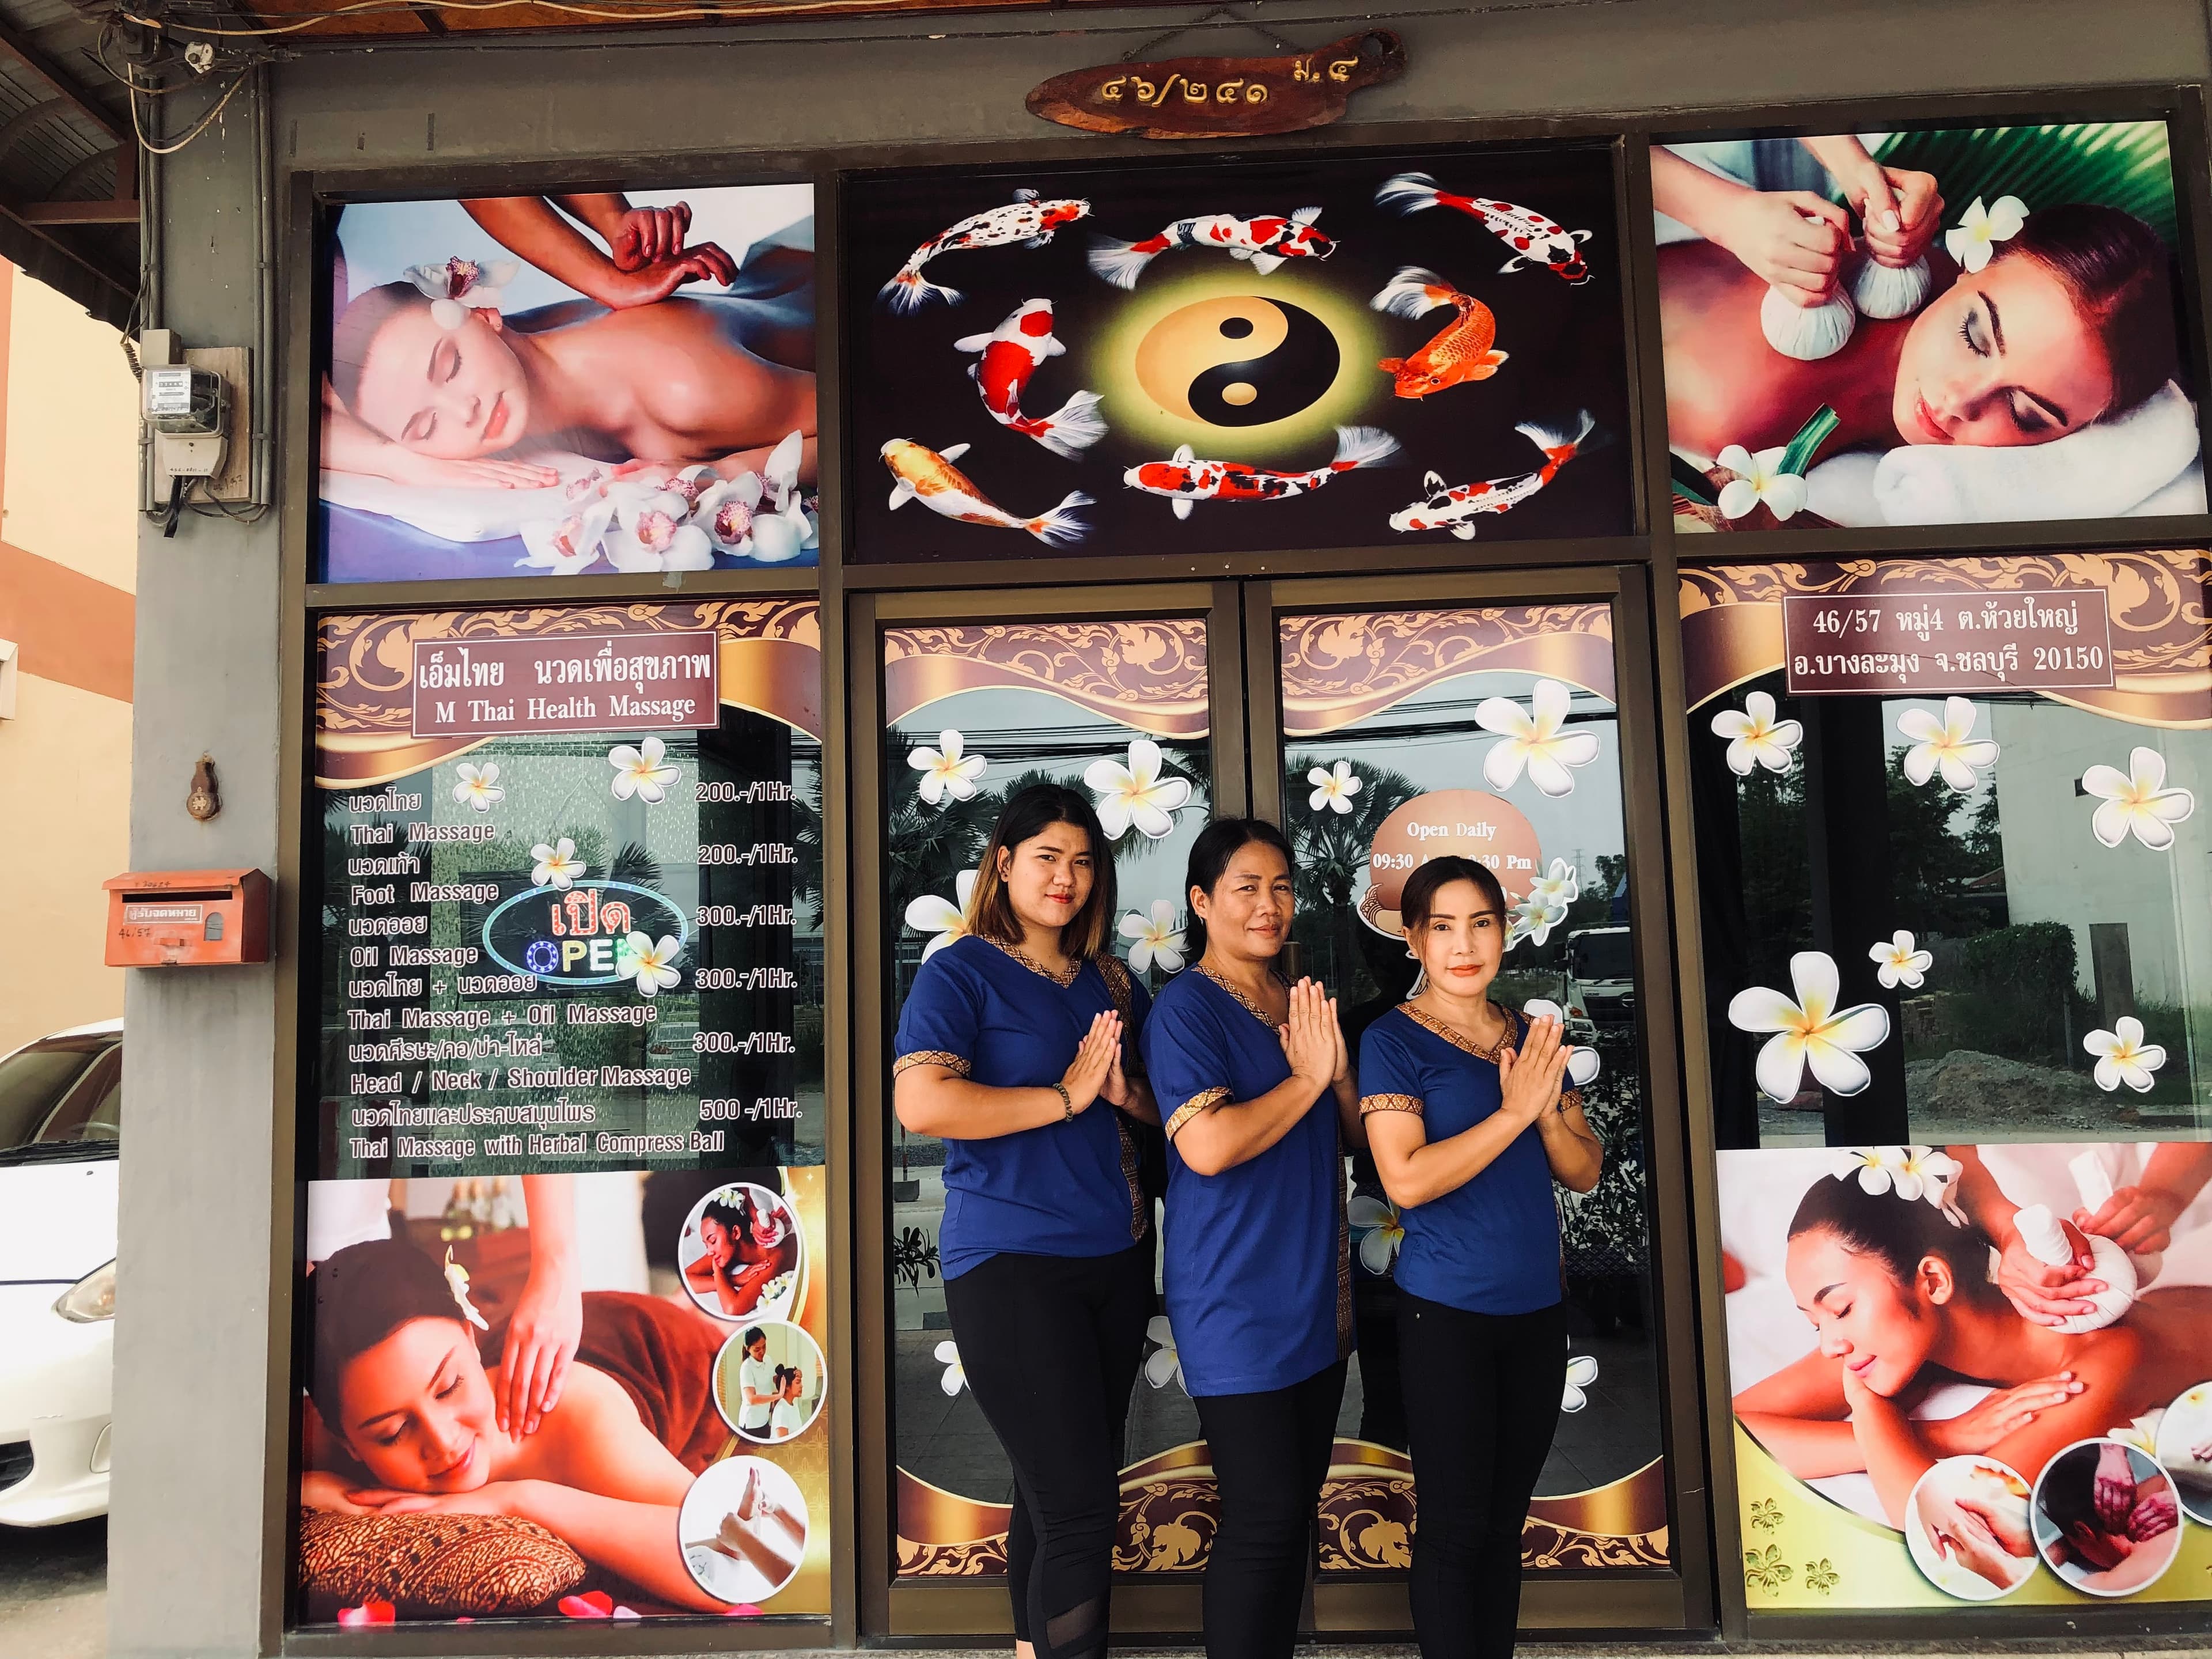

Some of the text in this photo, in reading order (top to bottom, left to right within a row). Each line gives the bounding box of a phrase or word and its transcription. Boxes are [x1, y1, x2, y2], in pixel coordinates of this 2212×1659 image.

[1812, 596, 2078, 642] 46/57 หมู่4 ต.ห้วยใหญ่
[419, 641, 711, 694] เอ็มไทย นวดเพื่อสุขภาพ
[1794, 642, 2103, 684] อ.บางละมุง จ.ชลบุรี 20150
[435, 695, 696, 723] M Thai Health Massage
[349, 786, 422, 813] นวดไทย
[695, 781, 798, 804] 200.-/1Hr.
[350, 822, 495, 844] Thai Massage
[1407, 821, 1497, 841] Open Daily
[349, 851, 421, 876] นวดเท้า
[697, 843, 798, 866] 200.-/1Hr.
[1373, 853, 1414, 870] 09:30
[1506, 855, 1532, 870] Pm
[351, 882, 499, 905] Foot Massage
[551, 888, 631, 936] เปิด
[696, 904, 797, 927] 300.-/1Hr.
[349, 915, 427, 936] นวดออย
[350, 945, 479, 968] Oil Massage
[349, 971, 422, 998] นวดไทย
[457, 974, 537, 995] นวดออย
[695, 968, 798, 990] 300.-/1Hr.
[347, 1009, 391, 1030] Thai
[402, 1008, 491, 1030] Massage
[527, 1004, 556, 1025] Oil
[567, 1004, 657, 1026] Massage
[692, 1032, 796, 1055] 300.-/1Hr.
[351, 1072, 403, 1094] Head
[433, 1070, 482, 1092] Neck
[507, 1066, 598, 1089] Shoulder
[601, 1066, 691, 1089] Massage
[351, 1097, 596, 1131] นวดไทยและประคบสมุนไพร
[349, 1130, 725, 1160] Thai Massage with Herbal Compress Ball
